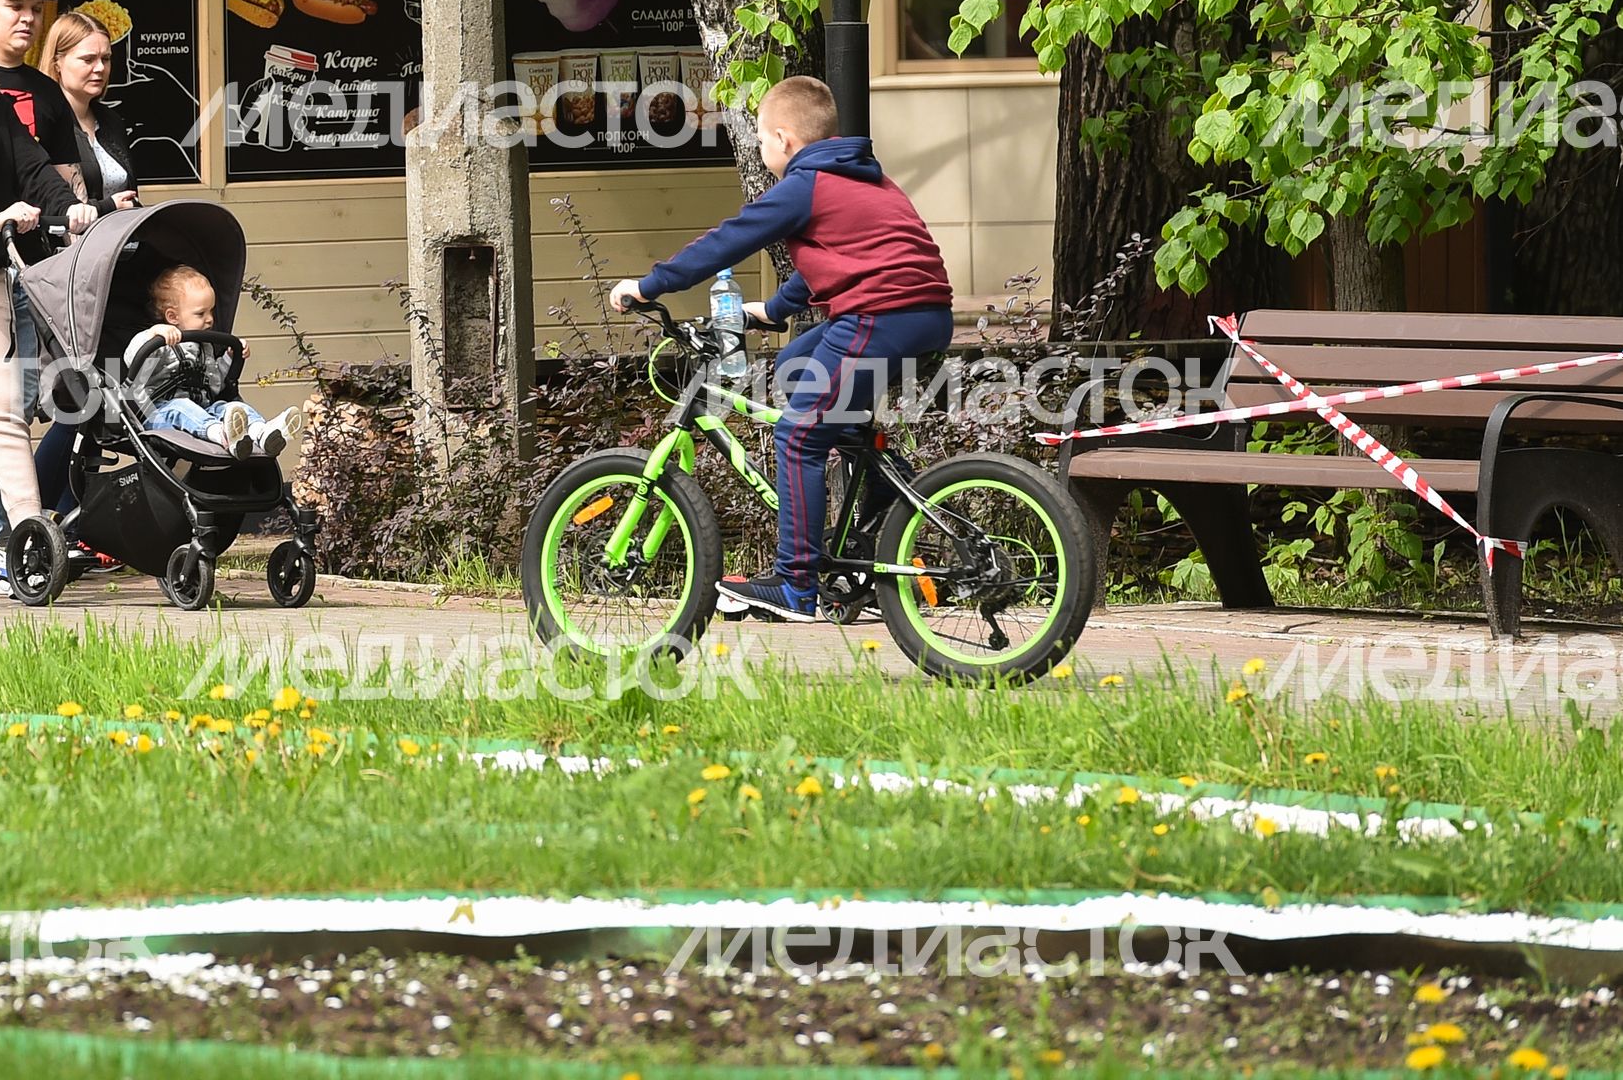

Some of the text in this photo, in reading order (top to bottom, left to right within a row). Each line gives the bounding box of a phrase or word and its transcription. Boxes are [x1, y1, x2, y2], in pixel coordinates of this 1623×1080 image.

[631, 9, 684, 21] СЛАДКАЯ
[661, 21, 685, 32] 100Р
[140, 32, 186, 42] кукуруза
[137, 45, 190, 56] россыпью
[323, 49, 378, 73] Кофе:
[647, 66, 670, 76] POP
[328, 79, 378, 93] Латте
[315, 105, 380, 121] Капучино
[304, 130, 380, 146] Американо
[597, 130, 650, 142] ПОПКОРН
[612, 142, 636, 154] 100Р
